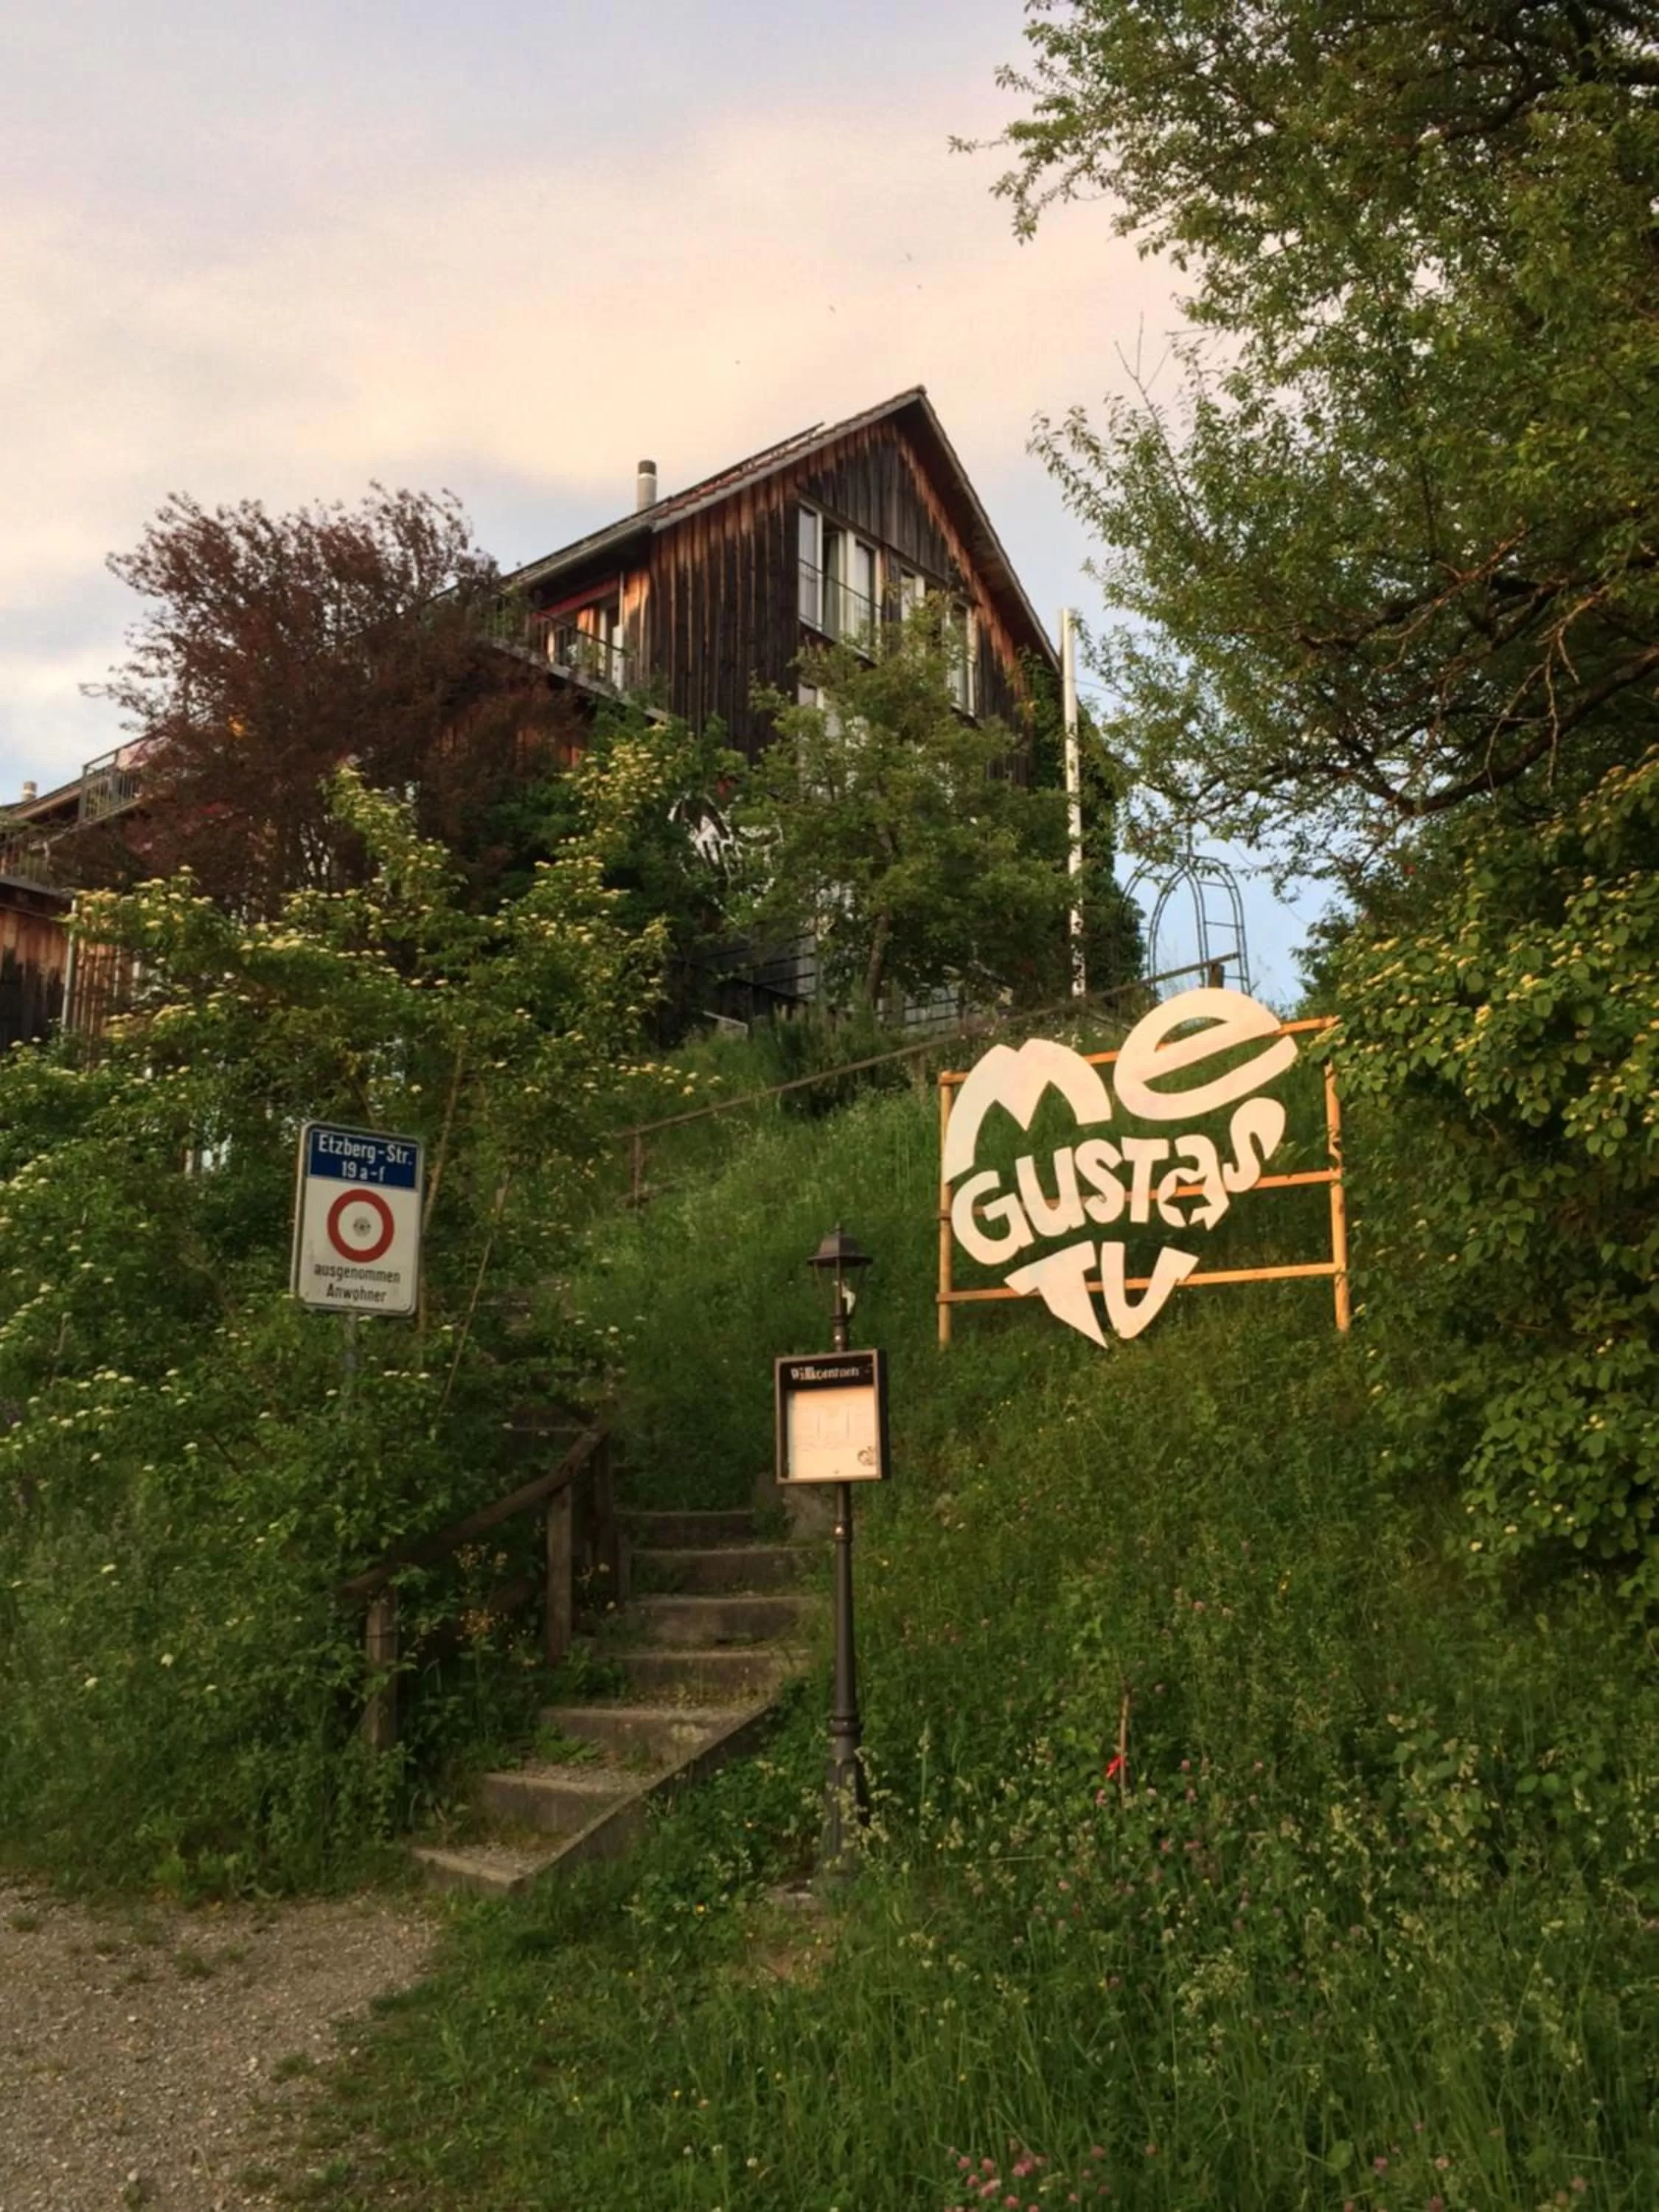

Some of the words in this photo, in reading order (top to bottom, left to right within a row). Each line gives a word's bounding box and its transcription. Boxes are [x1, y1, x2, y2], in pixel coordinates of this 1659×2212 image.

[318, 1133, 413, 1165] Etzberg-Str.
[313, 1263, 400, 1283] ausgenommen
[326, 1284, 387, 1303] Anwohner
